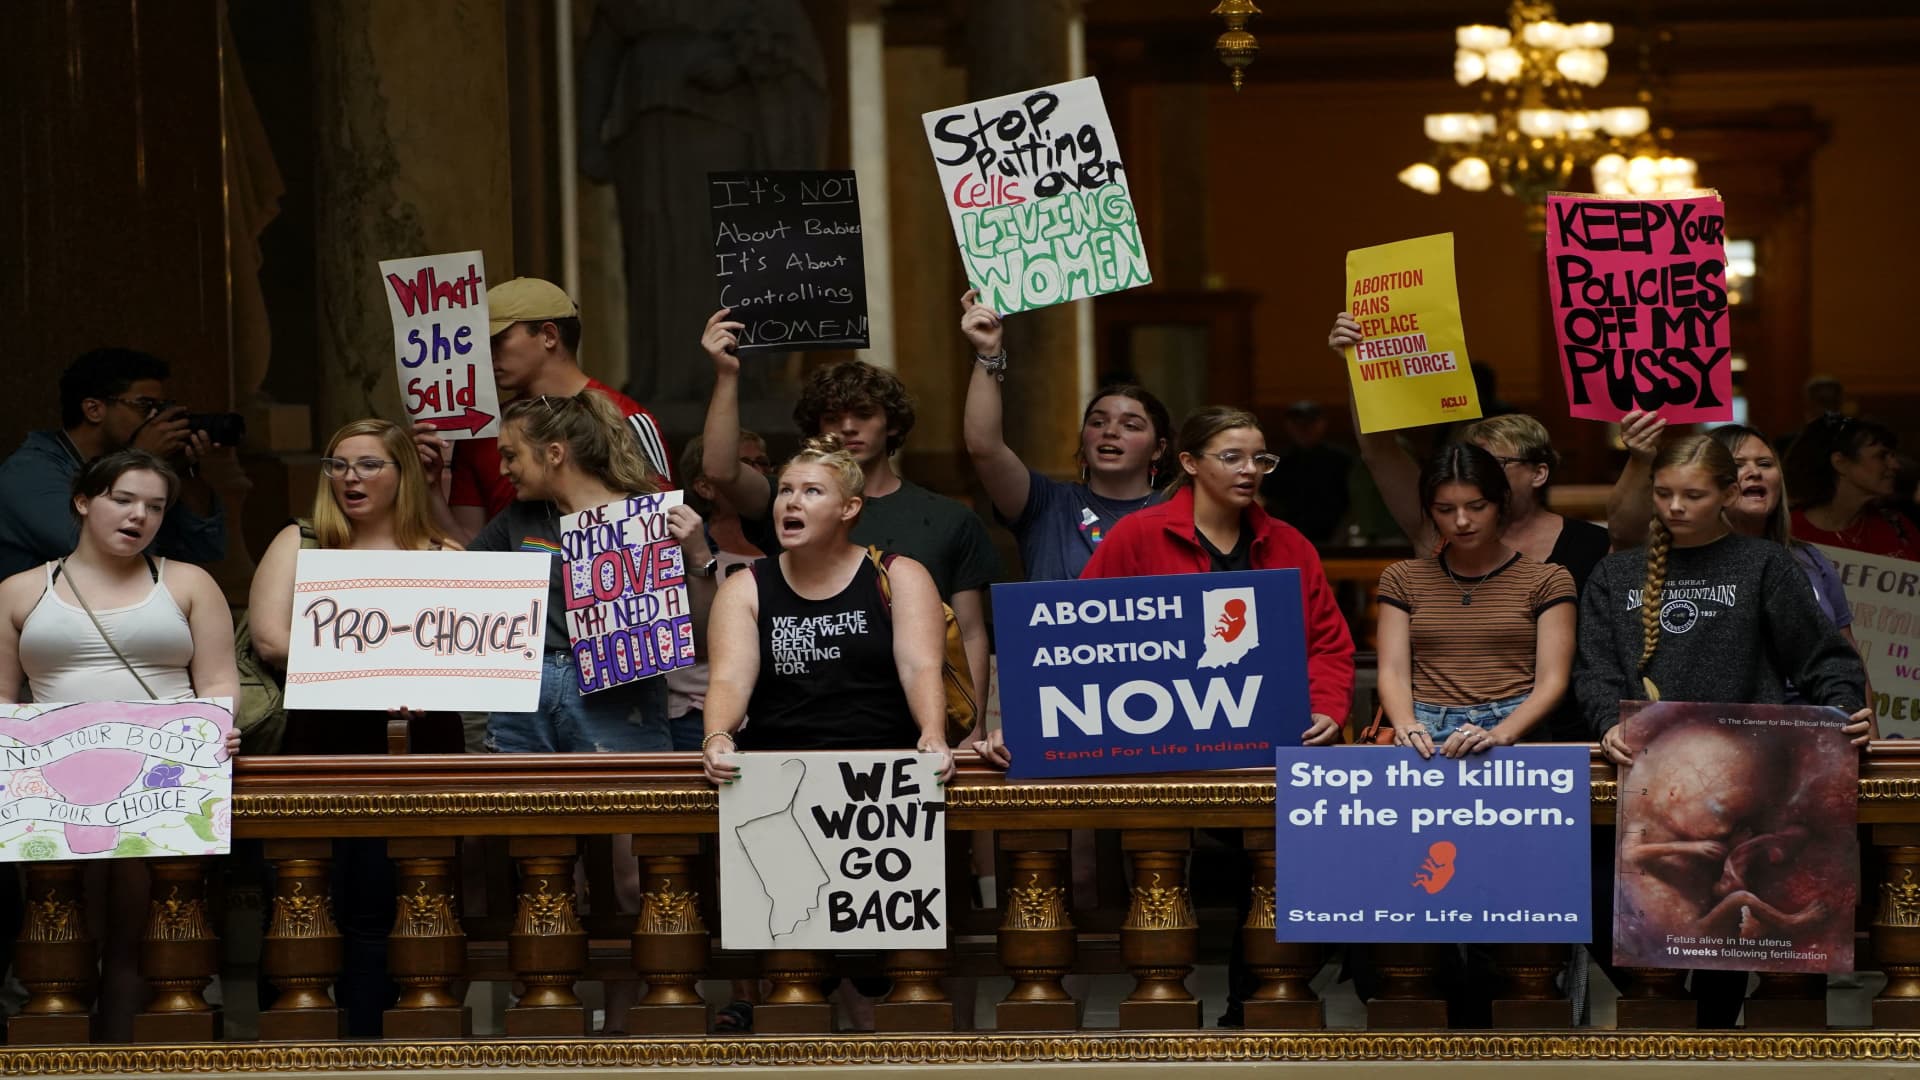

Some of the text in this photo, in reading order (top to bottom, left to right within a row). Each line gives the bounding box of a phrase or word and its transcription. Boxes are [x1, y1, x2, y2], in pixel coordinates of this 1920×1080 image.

[713, 177, 855, 208] It's NOT
[716, 219, 860, 246] About Babies
[961, 183, 1135, 259] LIVING
[1555, 202, 1666, 255] KEEP
[716, 248, 847, 277] It's About
[960, 223, 1152, 314] WOMEN
[386, 264, 482, 317] What
[721, 283, 853, 309] Controlling
[1353, 269, 1424, 297] ABORTION
[1556, 255, 1728, 311] POLICIES
[1352, 296, 1390, 317] BANS
[1359, 314, 1419, 338] EPLACE
[1564, 307, 1728, 349] OFF MY
[1356, 335, 1427, 360] FREEDOM
[1360, 353, 1456, 381] WITH FORCE.
[1564, 345, 1730, 412] PUSSY
[1441, 396, 1467, 408] ACLU
[578, 493, 664, 529] ONE DAY
[561, 518, 630, 562] SOMEONE
[562, 538, 684, 611] LOVE
[1832, 560, 1920, 597] EFOR
[1029, 596, 1183, 627] ABOLISH
[1668, 584, 1736, 607] MOUNTAINS
[303, 597, 541, 659] PRO-CHOICE!
[574, 589, 680, 637] MAY NEED A
[772, 610, 867, 628] WE ARE THE
[771, 622, 869, 640] ONES WE'VE
[771, 638, 815, 652] BEEN
[573, 615, 696, 693] CHOICE
[773, 646, 840, 662] WAITING
[774, 662, 810, 675] FOR.
[1032, 640, 1186, 667] ABORTION
[1039, 675, 1263, 738] NOW
[6, 725, 205, 768] NOT YOUR BODY
[1044, 741, 1270, 761] Stand For Life Indiana
[838, 758, 920, 802] WE
[1290, 760, 1574, 794] Stop the killing
[49, 803, 92, 823] YOUR
[104, 790, 188, 824] CHOICE
[811, 798, 945, 841] WON'T
[1289, 799, 1575, 833] of the preborn.
[840, 847, 911, 882] GO
[828, 888, 941, 933] BACK
[1288, 910, 1578, 922] Stand For Life Indiana
[1666, 934, 1792, 947] Fetus alive in the uterus
[1666, 947, 1827, 960] 10 weeks following fertilization
